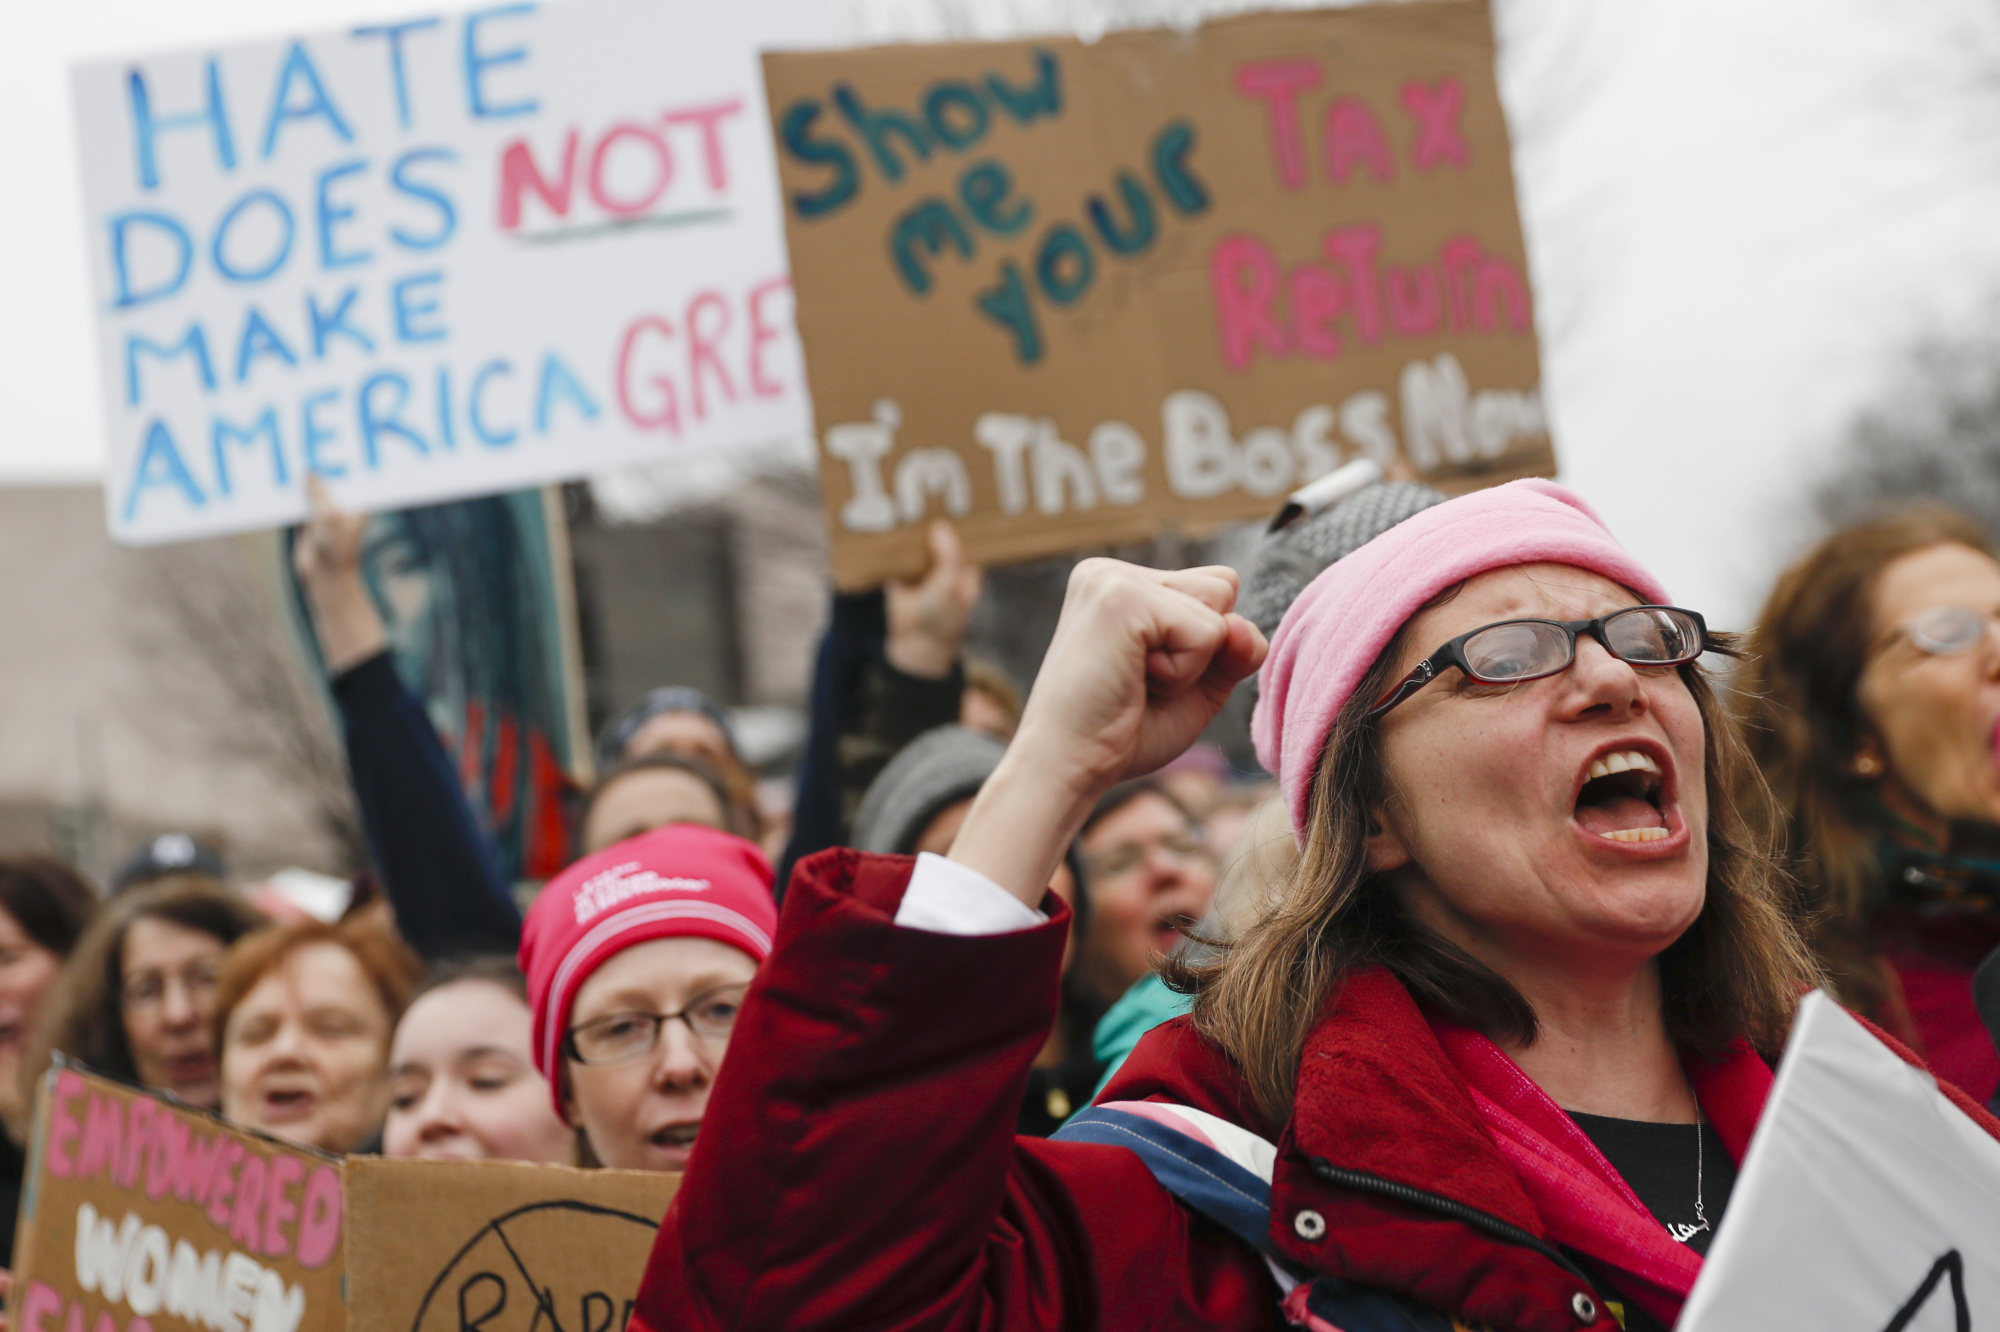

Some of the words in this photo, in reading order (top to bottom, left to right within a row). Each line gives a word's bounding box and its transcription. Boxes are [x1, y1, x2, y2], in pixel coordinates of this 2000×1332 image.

[129, 2, 539, 189] HATE
[780, 48, 1063, 221] Show
[110, 148, 458, 306] DOES
[497, 95, 741, 231] NOT
[888, 158, 1036, 298] me
[976, 116, 1213, 366] your
[121, 352, 600, 522] AMERICA
[615, 274, 804, 437] GRE
[127, 270, 448, 405] MAKE
[825, 397, 971, 531] I'm
[973, 411, 1148, 516] The
[47, 1069, 343, 1269] EMPOWERED
[74, 1202, 305, 1331] WOMEN
[459, 1271, 634, 1331] RAP
